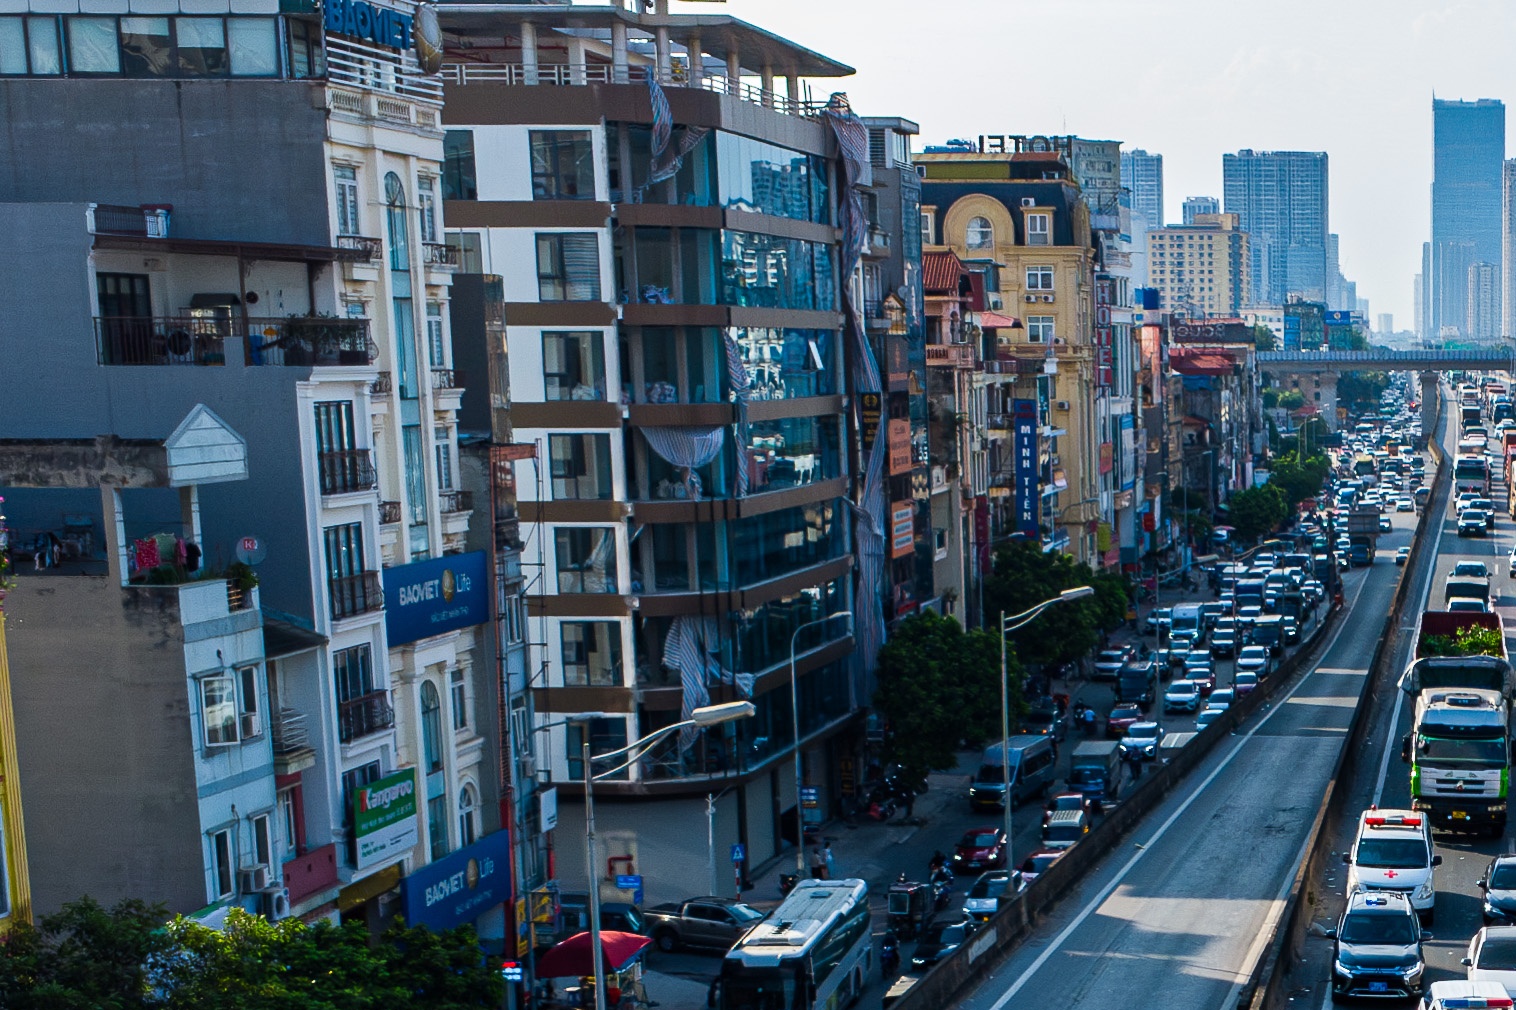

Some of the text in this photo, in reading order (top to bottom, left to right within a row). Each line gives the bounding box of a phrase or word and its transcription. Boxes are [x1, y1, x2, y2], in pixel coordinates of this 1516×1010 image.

[1097, 284, 1112, 386] HOTEL
[1021, 425, 1032, 469] MINH
[399, 573, 471, 606] BAOVIET Life
[360, 780, 413, 813] Kangaroo
[425, 870, 465, 907] BAOVIET
[479, 857, 494, 878] Life
